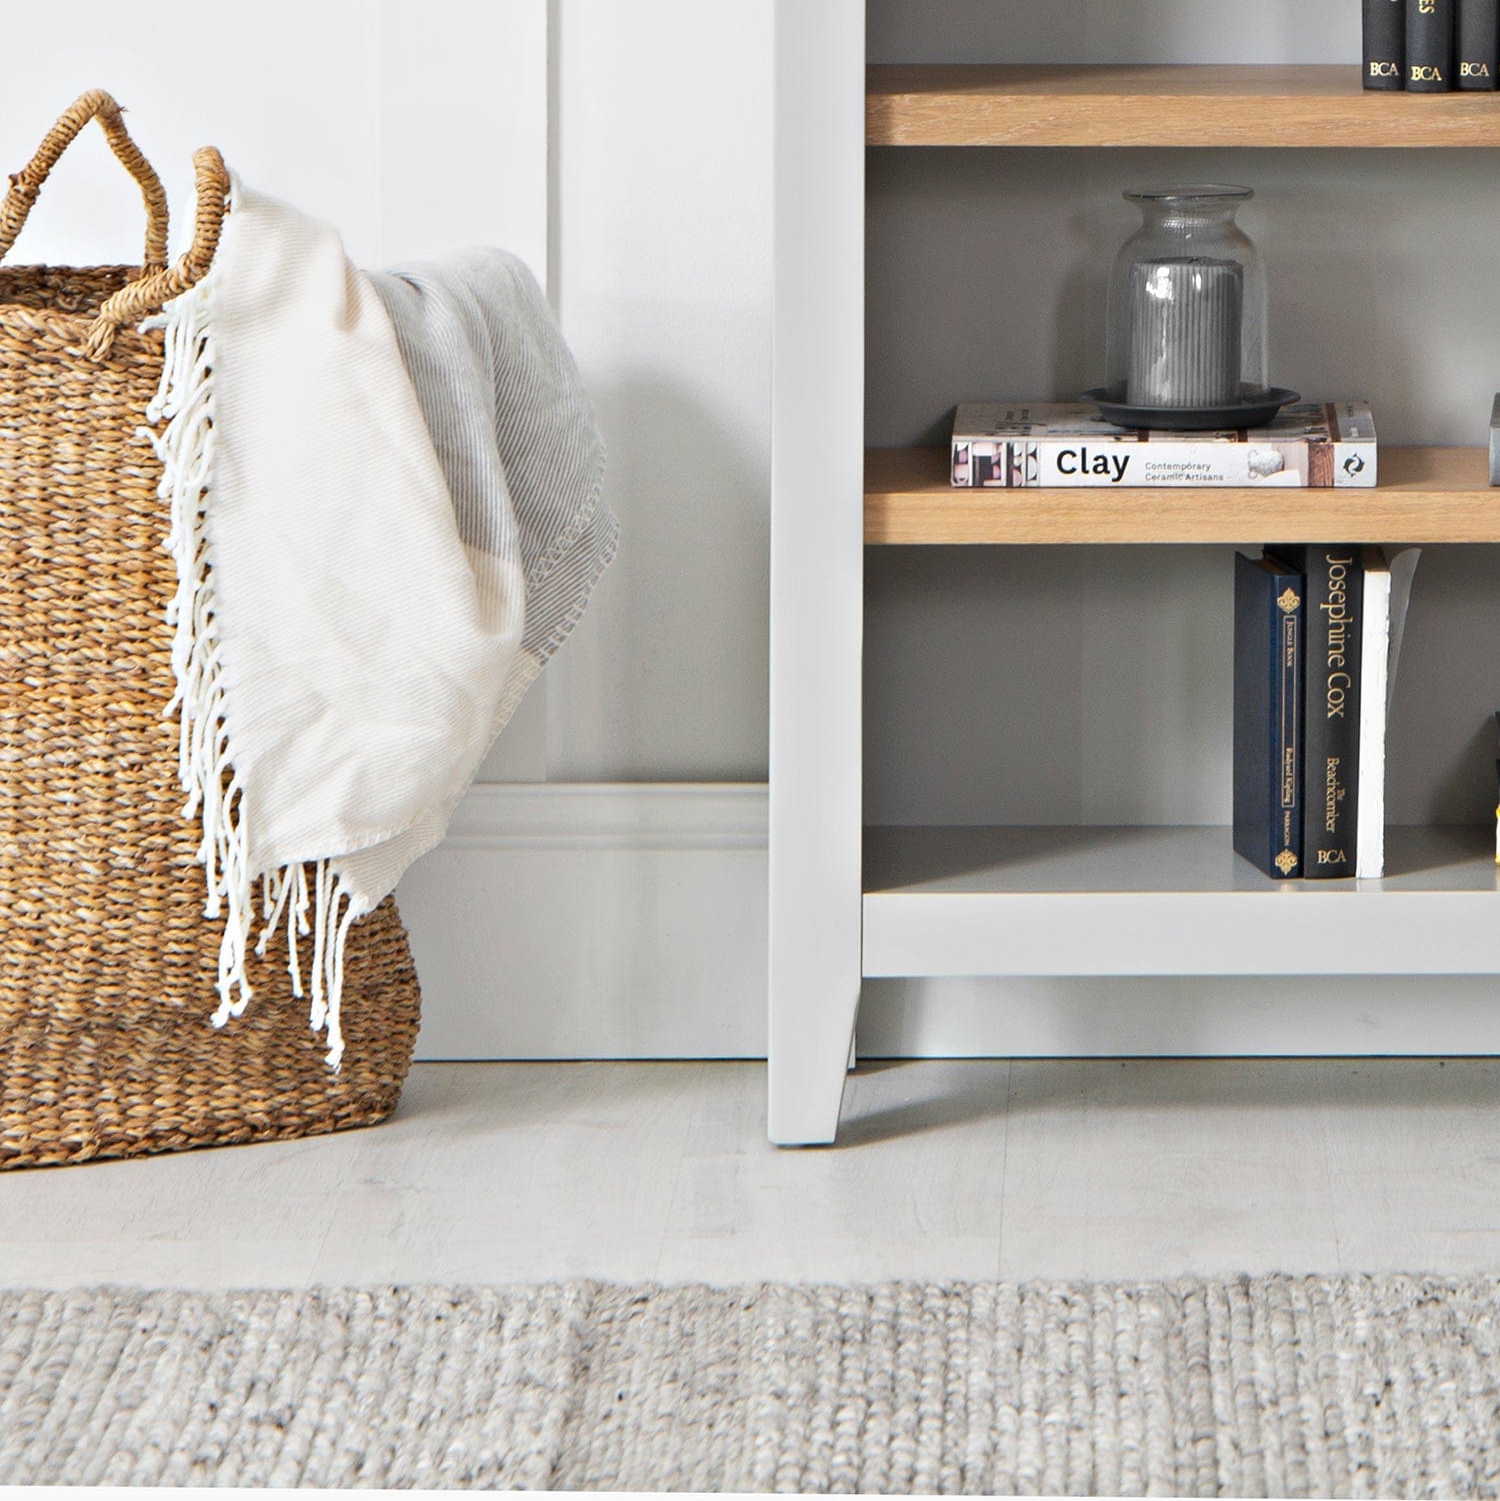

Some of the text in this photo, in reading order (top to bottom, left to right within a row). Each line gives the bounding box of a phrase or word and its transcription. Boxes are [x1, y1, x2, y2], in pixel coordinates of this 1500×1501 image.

[1369, 61, 1399, 77] BCA
[1411, 66, 1443, 81] BCA
[1459, 61, 1490, 77] BCA
[1056, 448, 1131, 483] Clay
[1144, 461, 1212, 473] Contemporary
[1144, 471, 1225, 483] Ceramic Artisans
[1319, 554, 1354, 719] Josephine Cox
[1326, 757, 1340, 833] Beachcomber
[1336, 788, 1346, 801] The
[1316, 849, 1347, 864] BCA
